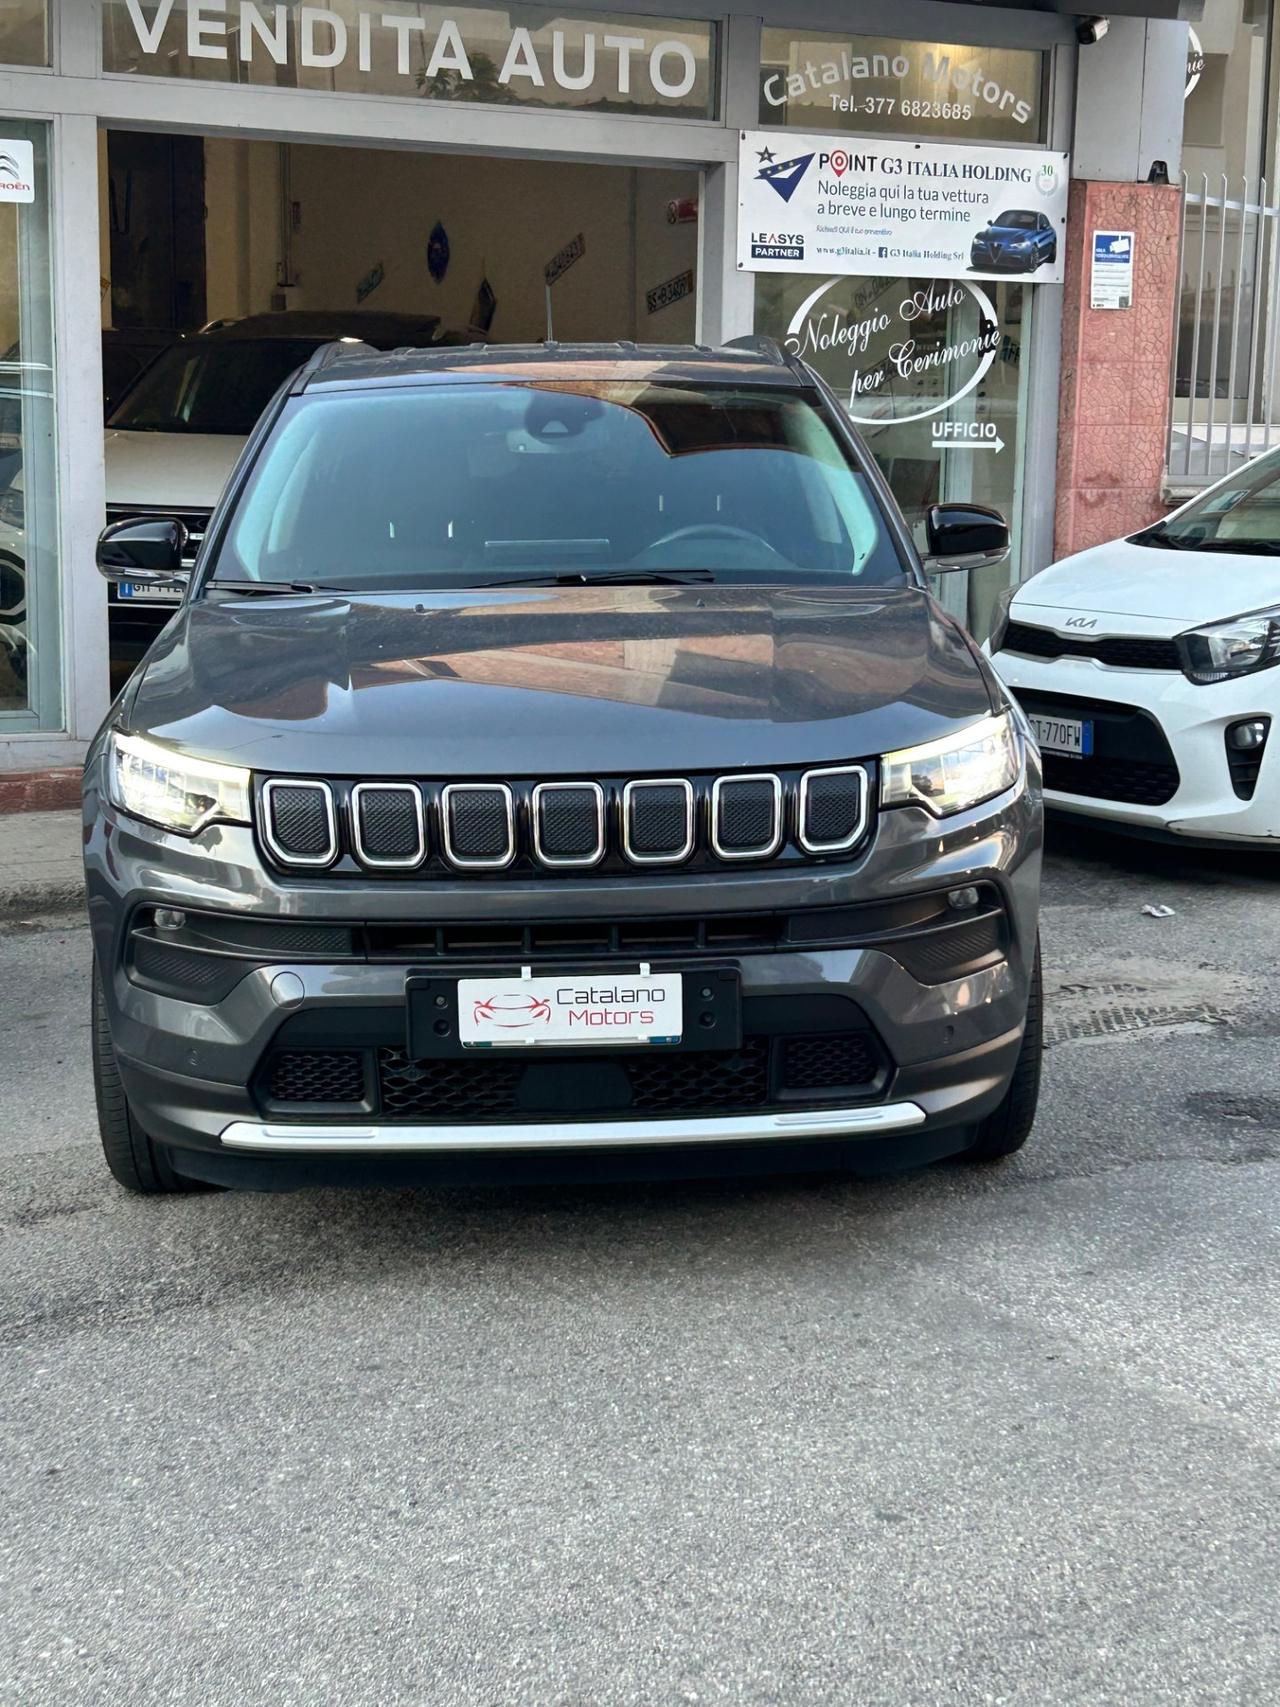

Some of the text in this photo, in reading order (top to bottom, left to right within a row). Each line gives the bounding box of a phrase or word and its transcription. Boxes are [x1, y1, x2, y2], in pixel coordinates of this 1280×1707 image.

[126, 0, 696, 98] VENDITA AUTO
[763, 51, 1032, 124] Catalano Motors
[829, 93, 972, 121] Tel. 377 6823685
[818, 150, 878, 176] POINT
[880, 156, 903, 175] G3
[907, 160, 959, 179] ITALIA
[962, 164, 1032, 183] HOLDING
[1040, 164, 1054, 177] 30
[818, 180, 989, 204] Noleggia qui la tua vettura
[817, 200, 971, 222] a breve e lungo termine
[751, 232, 804, 245] LEASYS
[755, 247, 800, 257] PARTNER
[890, 248, 901, 257] G3
[903, 249, 921, 258] Italia
[923, 250, 952, 261] Holding
[953, 251, 964, 260] Srl
[784, 307, 892, 358] Noleggio
[899, 278, 967, 321] Auto
[849, 369, 887, 409] per
[888, 323, 1002, 381] Cerimonie
[932, 421, 997, 438] UFFICIO
[1065, 617, 1098, 628] KIA
[556, 986, 666, 1005] Catalano
[569, 1008, 654, 1027] Motors
